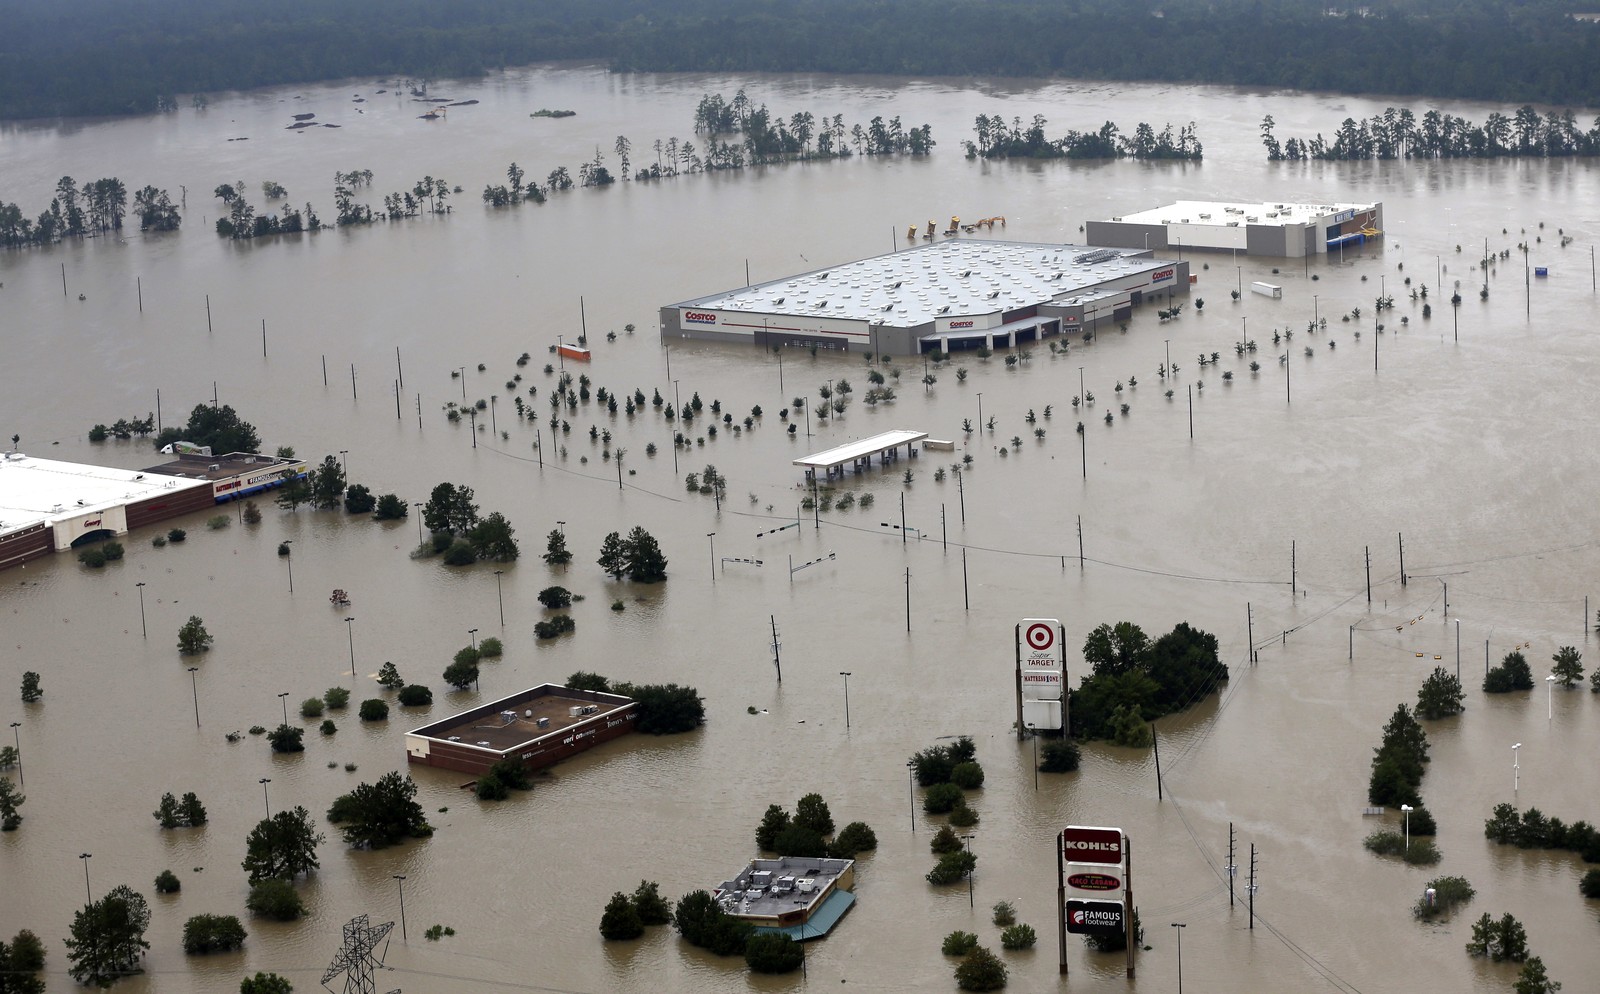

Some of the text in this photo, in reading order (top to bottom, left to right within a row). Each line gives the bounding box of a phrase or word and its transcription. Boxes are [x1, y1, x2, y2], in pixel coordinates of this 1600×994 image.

[685, 311, 716, 321] COSTCO
[1030, 650, 1051, 659] Super
[1066, 841, 1119, 851] KOHL'S
[1084, 910, 1120, 921] FAMOUS
